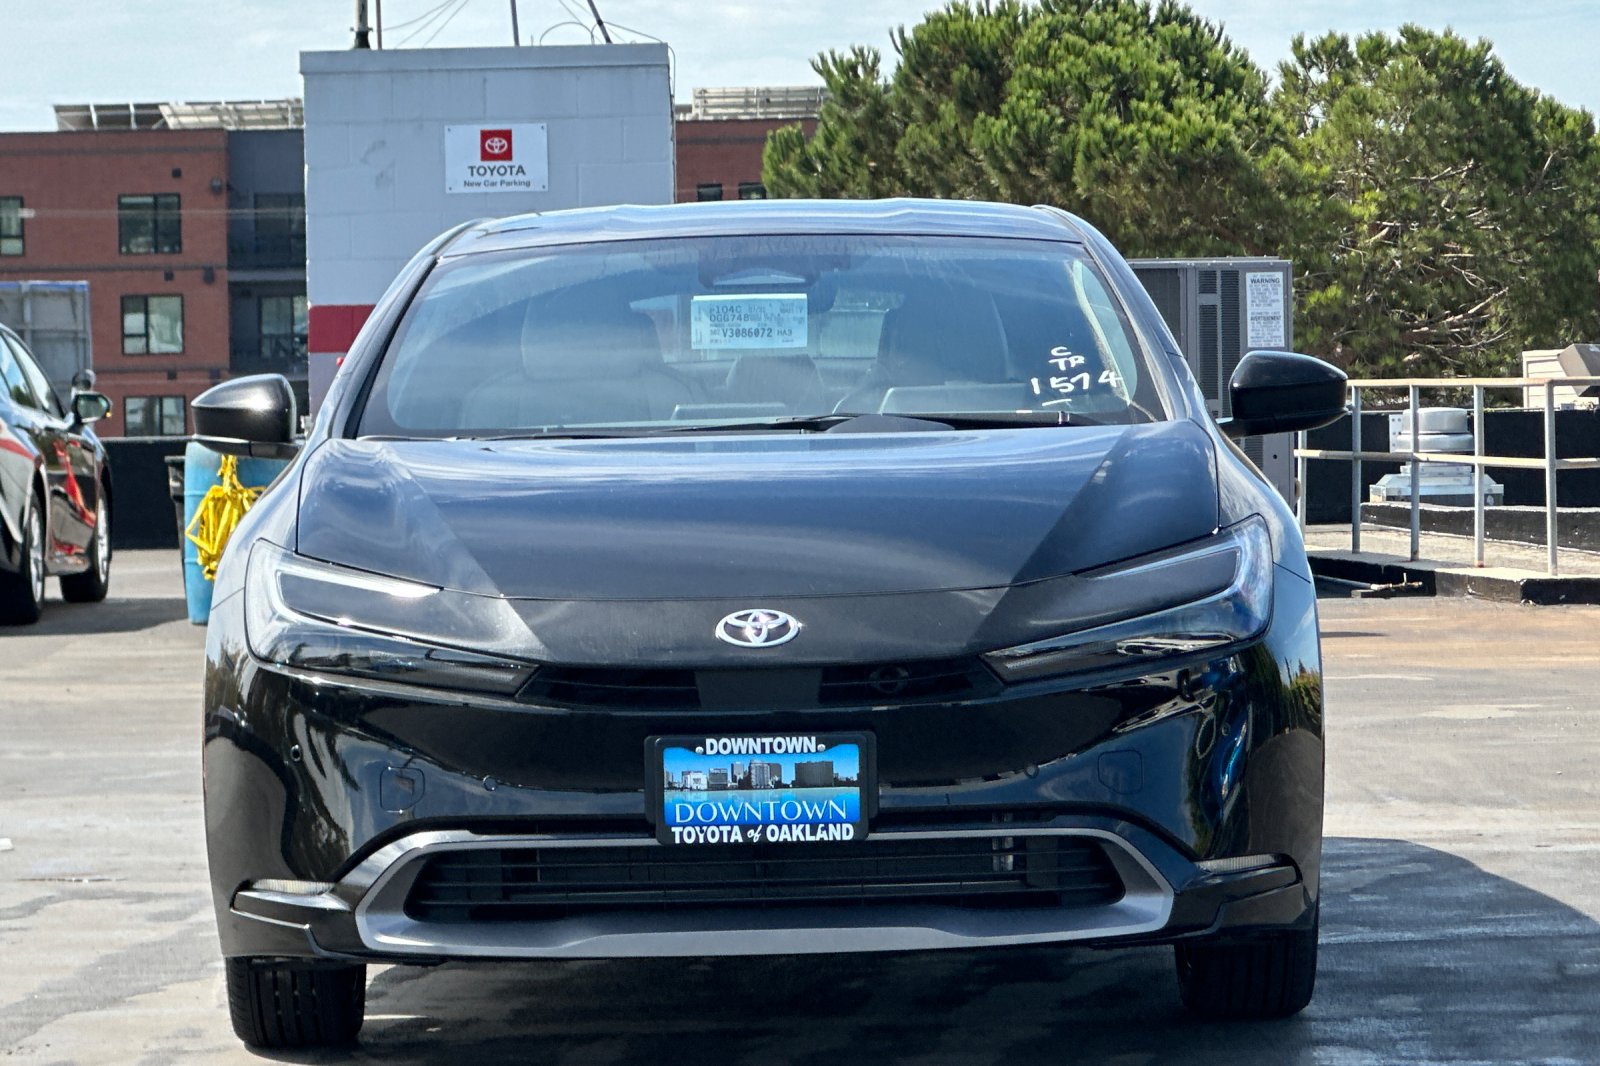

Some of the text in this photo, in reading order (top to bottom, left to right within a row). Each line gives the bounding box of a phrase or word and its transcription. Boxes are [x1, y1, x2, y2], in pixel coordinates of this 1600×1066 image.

[467, 164, 527, 177] TOYOTA
[463, 180, 482, 188] New
[499, 179, 531, 188] Parking
[705, 736, 817, 755] DOWNTOWN
[675, 799, 848, 823] DOWNTOWN
[671, 823, 855, 844] TOYOTA of OAKLAND
